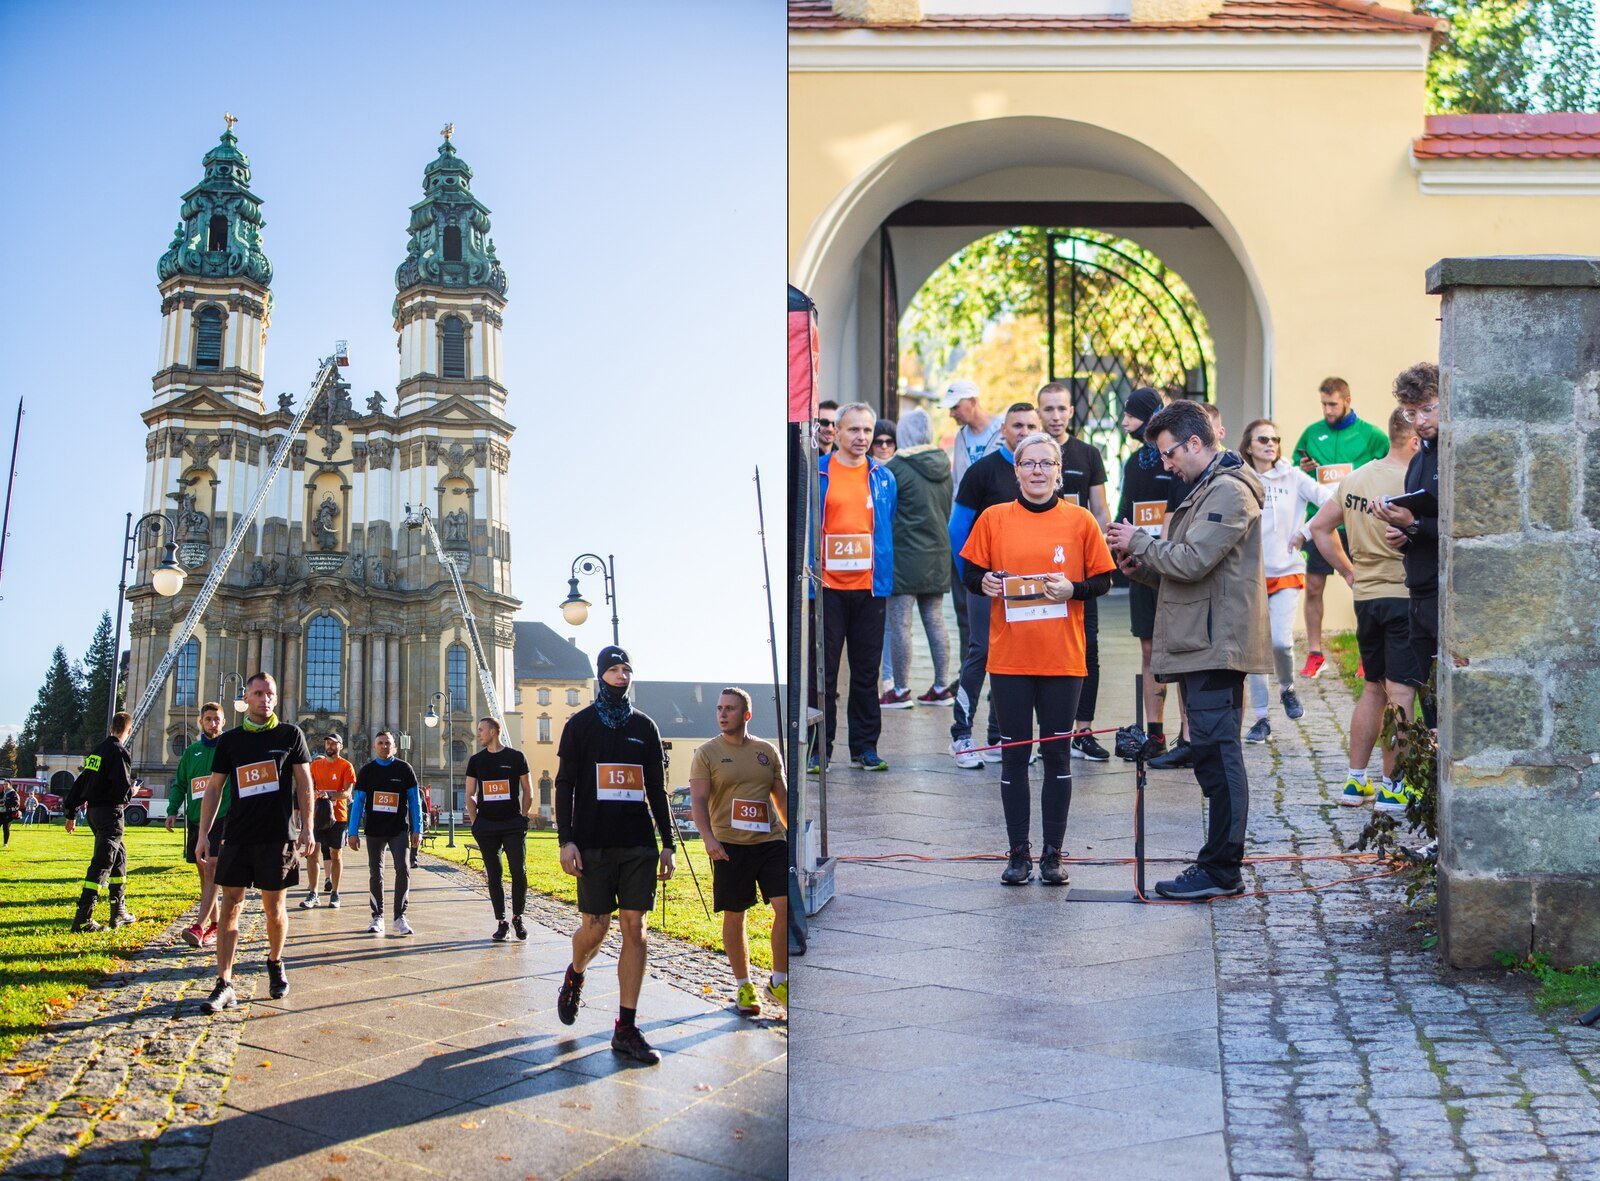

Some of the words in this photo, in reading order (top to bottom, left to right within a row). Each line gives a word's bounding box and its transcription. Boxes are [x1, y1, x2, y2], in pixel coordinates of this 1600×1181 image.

[1322, 469, 1338, 481] 20
[1140, 507, 1153, 521] 15
[835, 541, 854, 555] 24
[1019, 584, 1036, 597] 11
[245, 769, 260, 782] 18
[608, 770, 625, 784] 15
[195, 780, 206, 790] 20
[488, 784, 498, 792] 19
[378, 795, 389, 804] 25
[740, 805, 757, 818] 39
